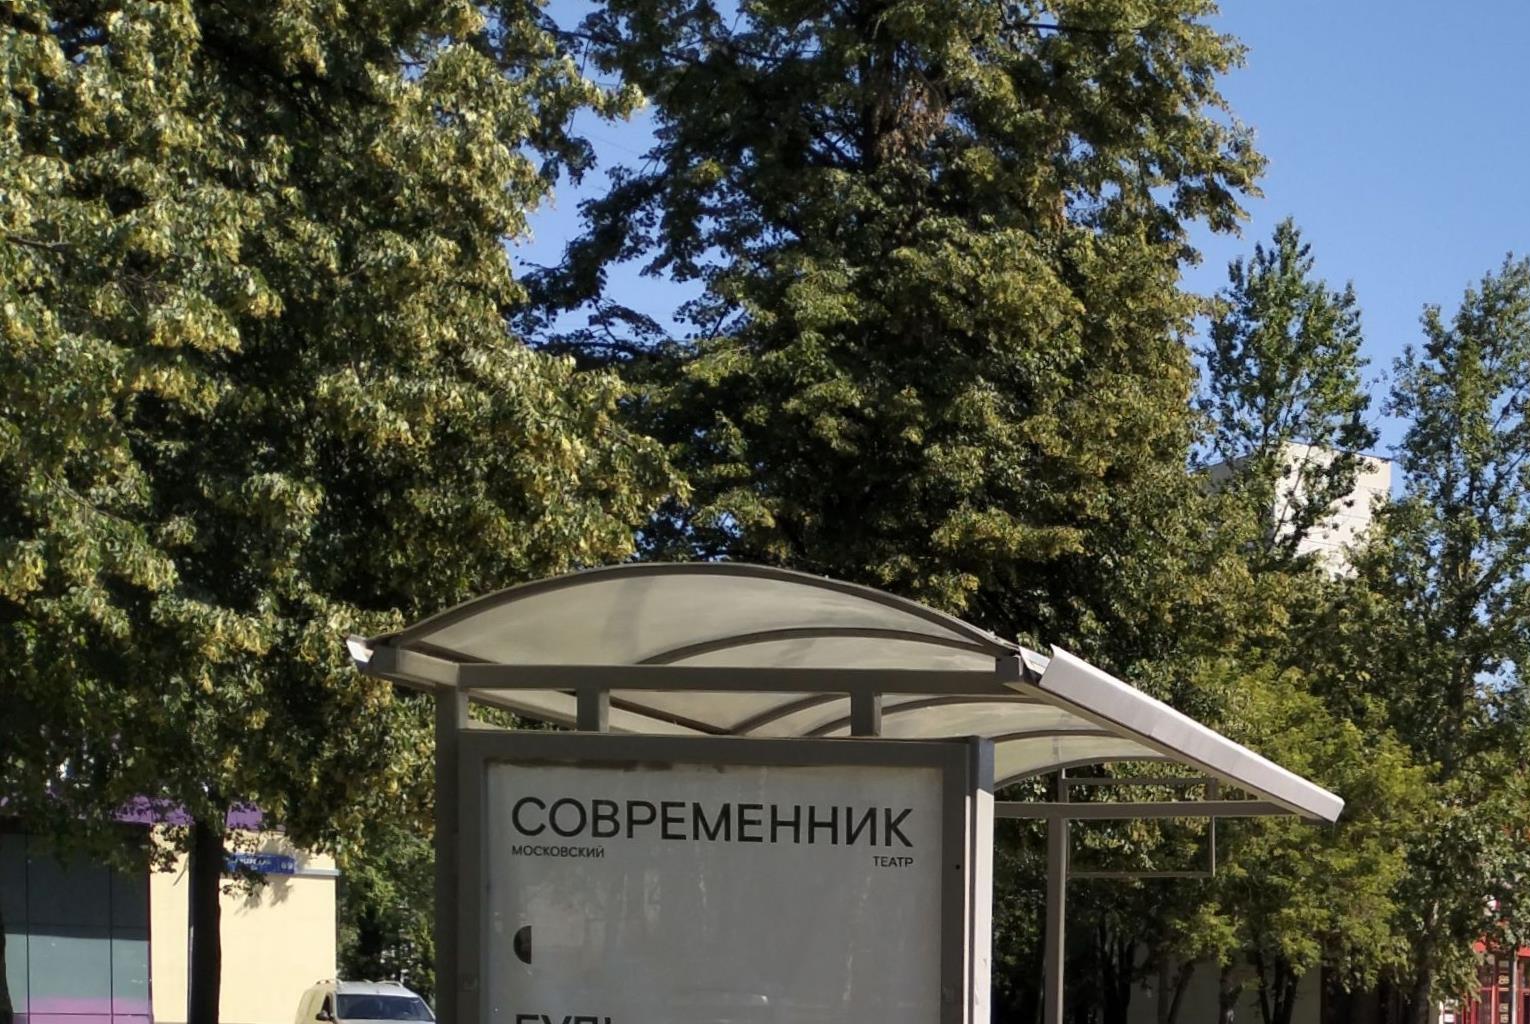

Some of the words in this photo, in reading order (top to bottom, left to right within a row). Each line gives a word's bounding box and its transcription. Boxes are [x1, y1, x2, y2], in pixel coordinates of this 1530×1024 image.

[512, 797, 914, 848] СОВРЕМЕННИК
[511, 844, 605, 858] МОСКОВСКИЙ
[873, 855, 914, 868] ТЕАТР
